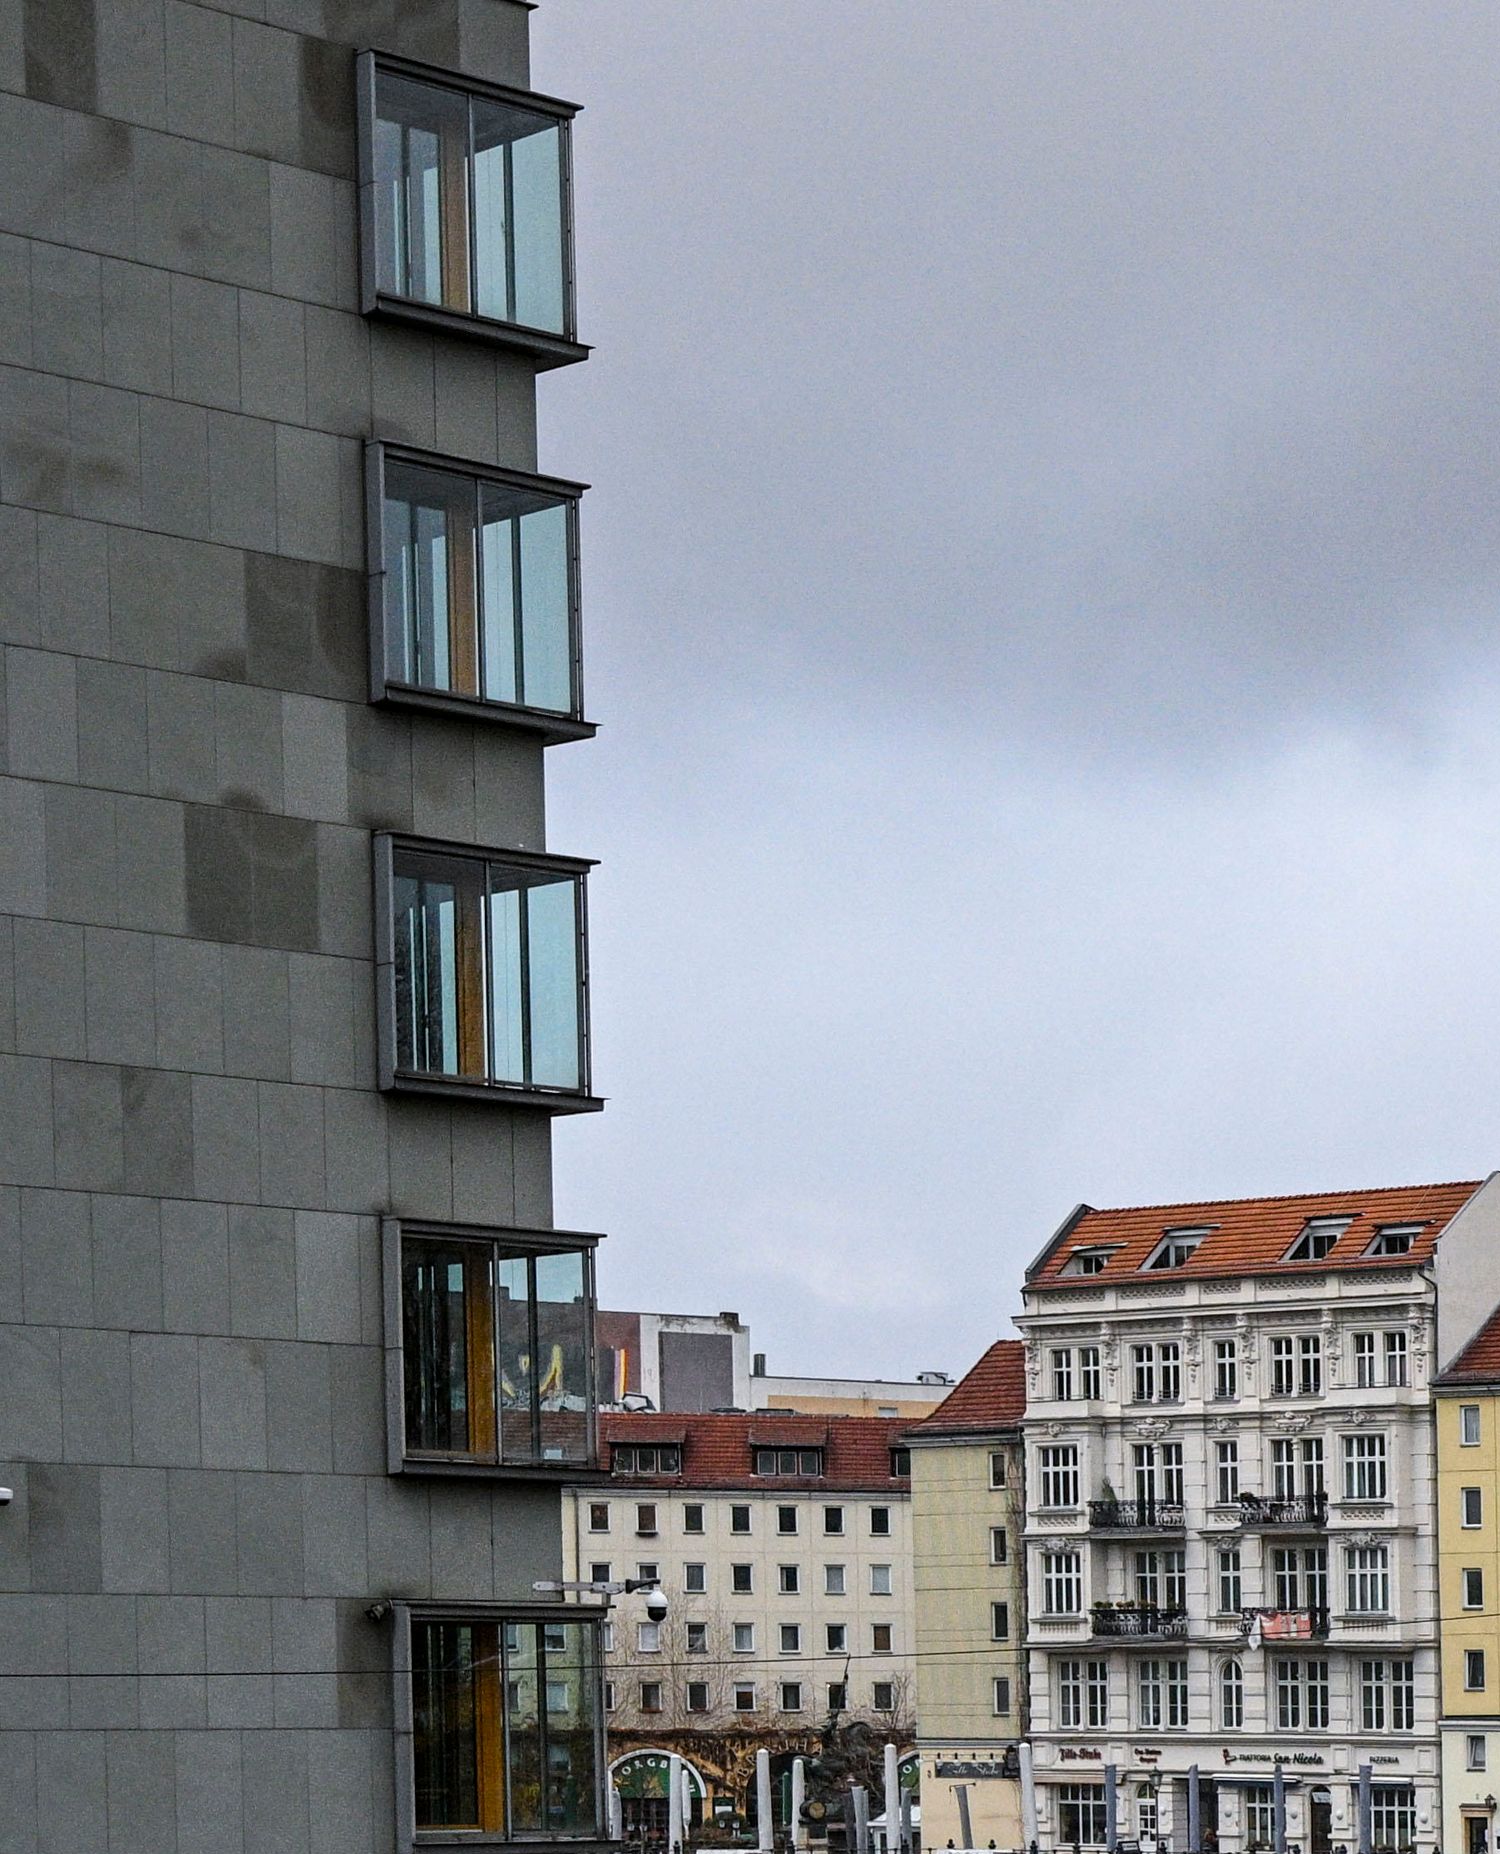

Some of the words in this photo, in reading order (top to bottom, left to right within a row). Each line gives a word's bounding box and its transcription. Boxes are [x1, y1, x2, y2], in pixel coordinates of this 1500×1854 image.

[1239, 1754, 1271, 1762] TRATTORIA
[1273, 1753, 1290, 1764] San
[1292, 1753, 1324, 1765] Nicola
[1370, 1756, 1399, 1764] PIZZERIA
